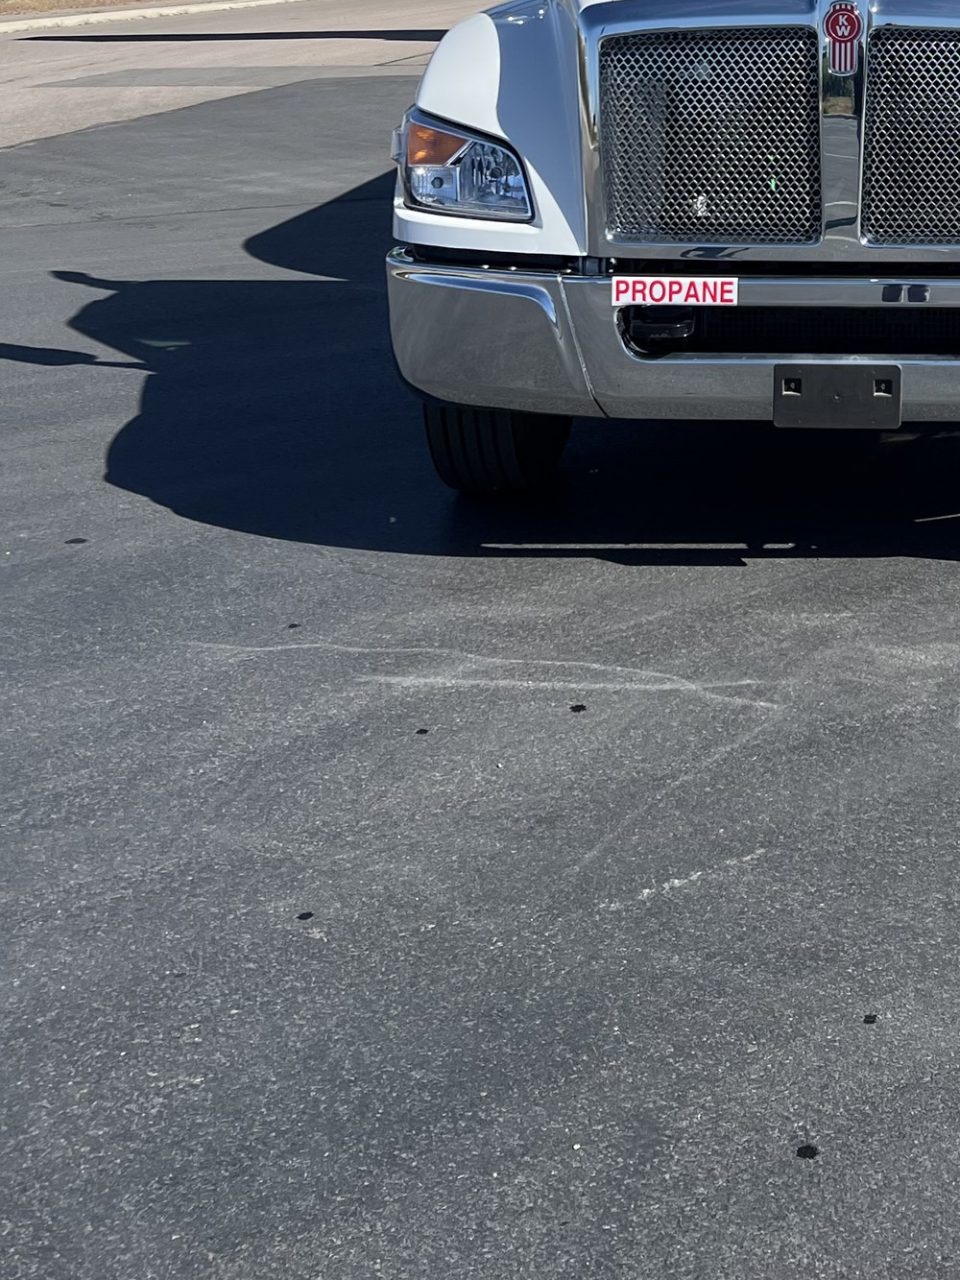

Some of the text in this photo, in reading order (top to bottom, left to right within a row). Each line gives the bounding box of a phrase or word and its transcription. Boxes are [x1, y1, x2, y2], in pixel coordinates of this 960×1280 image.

[838, 14, 849, 26] K
[835, 25, 851, 37] W
[615, 279, 734, 303] PROPANE
